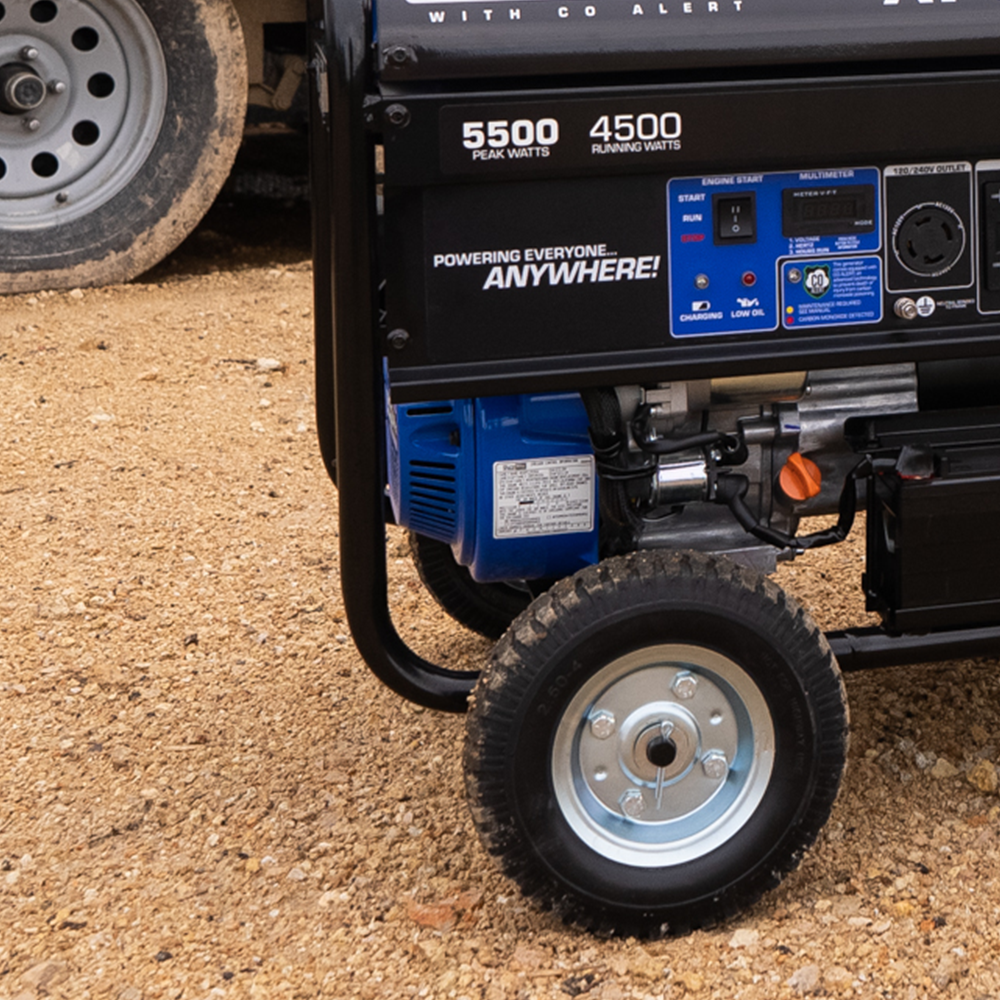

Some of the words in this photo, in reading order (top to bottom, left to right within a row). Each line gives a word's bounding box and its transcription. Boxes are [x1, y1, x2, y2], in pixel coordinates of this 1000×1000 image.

[429, 8, 521, 23] WITH
[558, 5, 596, 18] CO
[632, 0, 743, 15] ALERT
[462, 118, 559, 149] 5500
[589, 112, 682, 142] 4500
[472, 148, 505, 160] PEAK
[506, 146, 550, 158] WATTS
[592, 141, 642, 154] RUNNING
[643, 139, 682, 151] WATTS
[799, 170, 855, 180] MULTIMETER
[936, 164, 966, 173] OUTLET
[702, 176, 735, 186] ENGINE
[736, 175, 764, 184] START
[678, 193, 706, 203] START
[682, 213, 702, 222] RUN
[434, 250, 521, 268] POWERING
[524, 244, 618, 262] EVERYONE...
[482, 255, 661, 290] ANYWHERE!
[811, 273, 824, 287] CO
[680, 311, 723, 322] CHARGING
[731, 309, 750, 318] LOW
[751, 308, 765, 317] OIL
